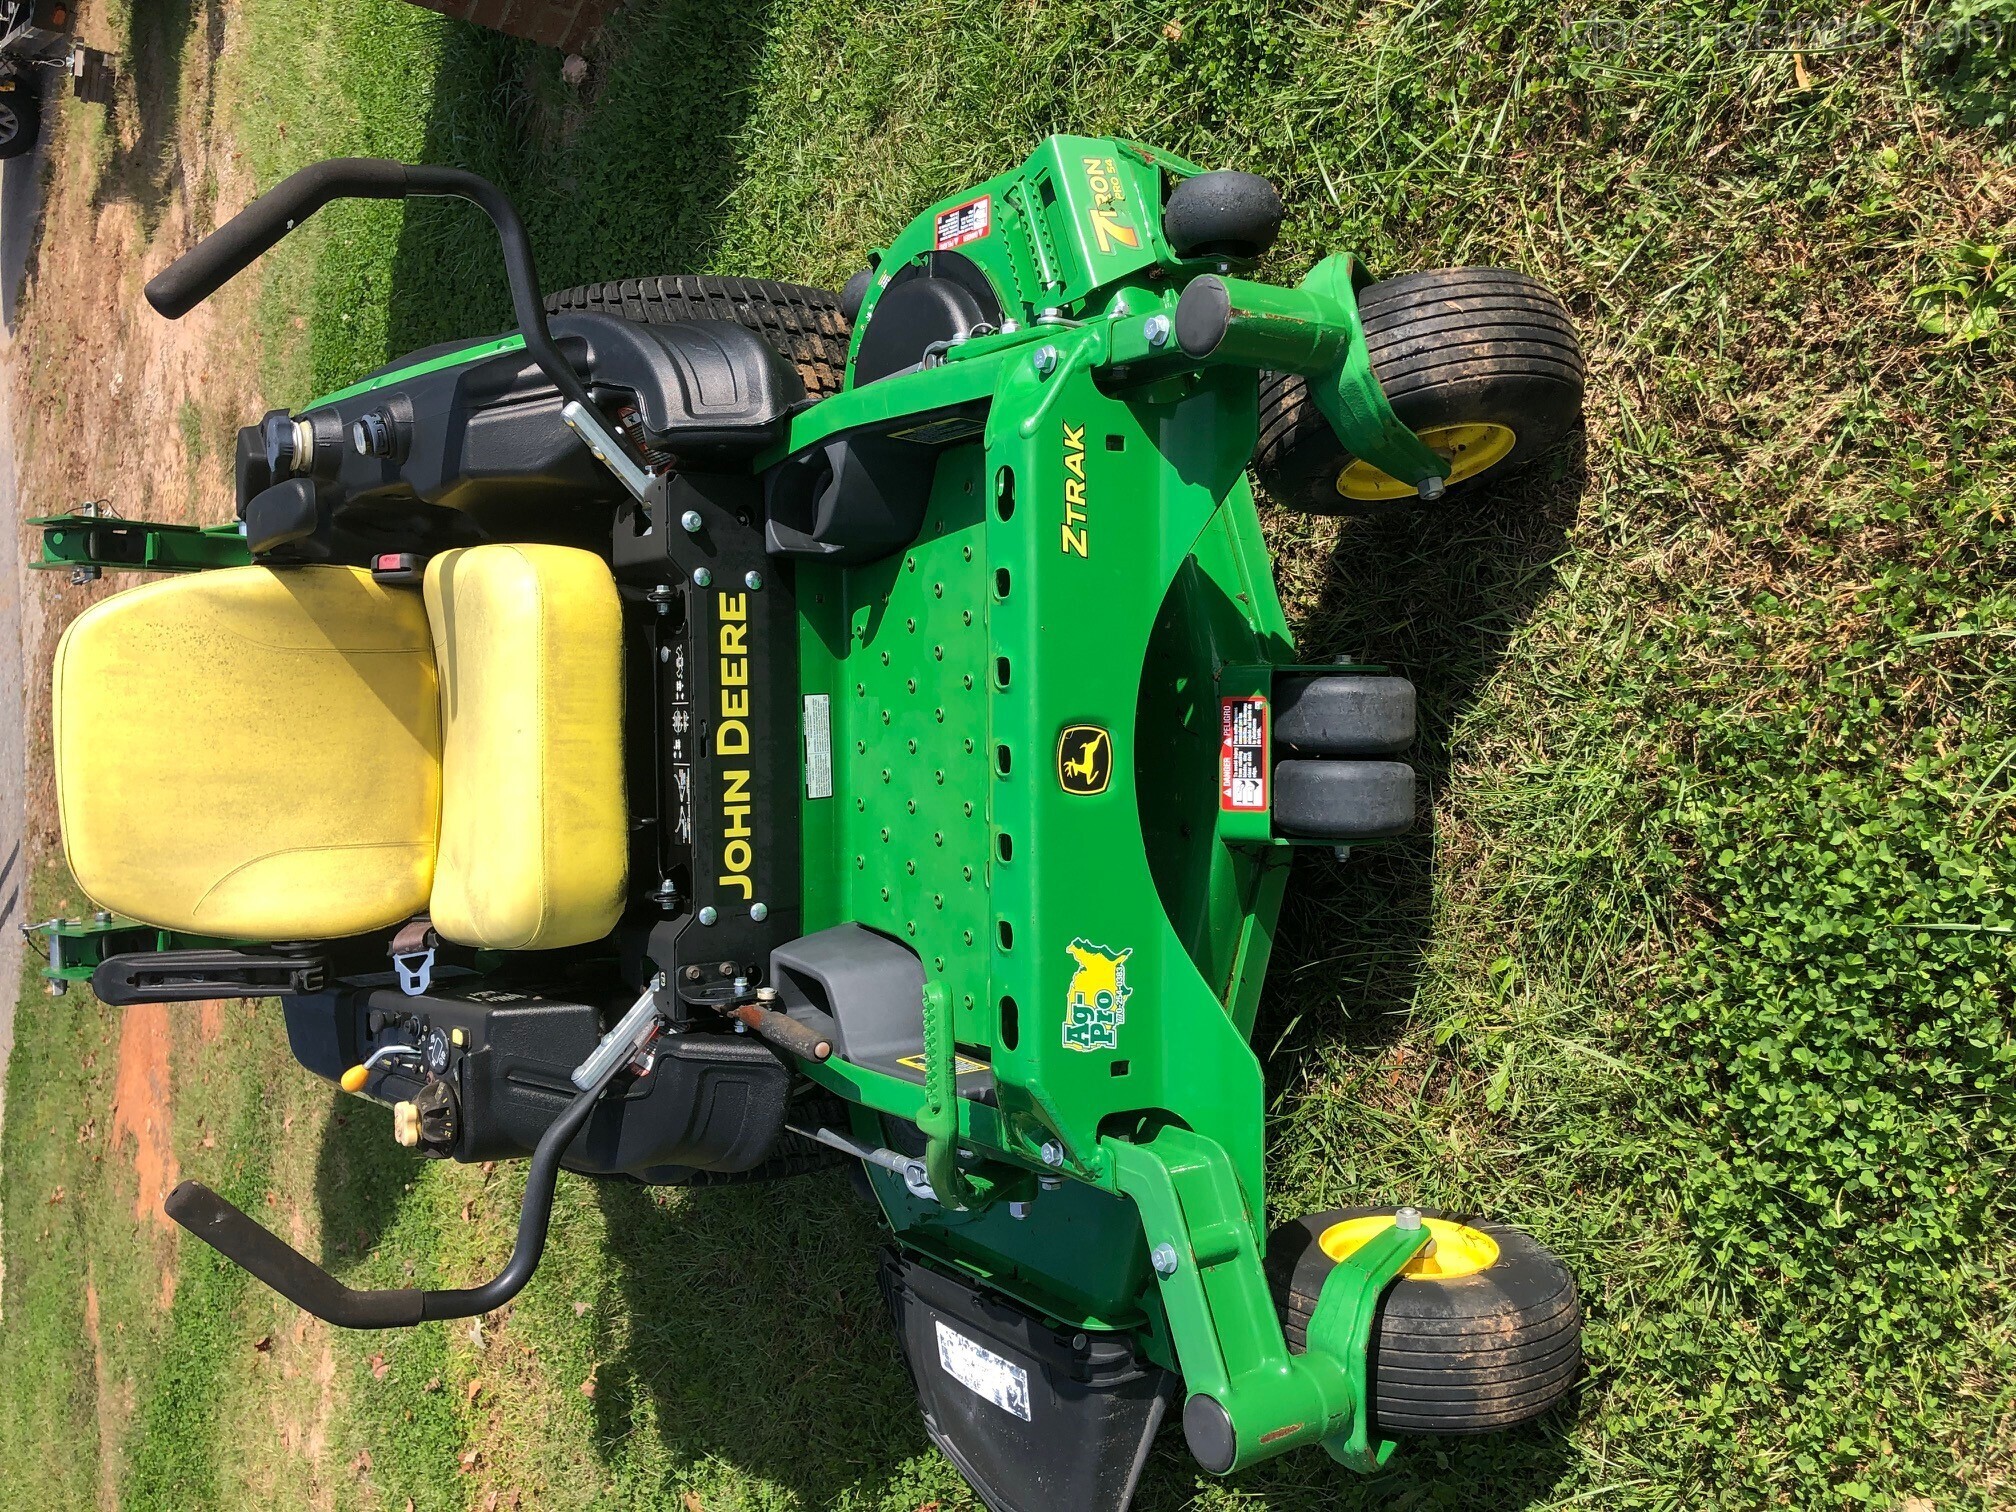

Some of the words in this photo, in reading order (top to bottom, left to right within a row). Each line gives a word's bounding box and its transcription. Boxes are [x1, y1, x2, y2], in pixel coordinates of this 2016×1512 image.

[1105, 158, 1116, 174] 54
[1111, 178, 1126, 200] PRO
[1061, 420, 1088, 559] ZTRAK
[715, 592, 750, 756] DEERE
[1223, 705, 1231, 737] PELIGRO
[1223, 758, 1231, 787] DANGER
[718, 770, 752, 900] JOHN
[1090, 991, 1113, 1044] Pro
